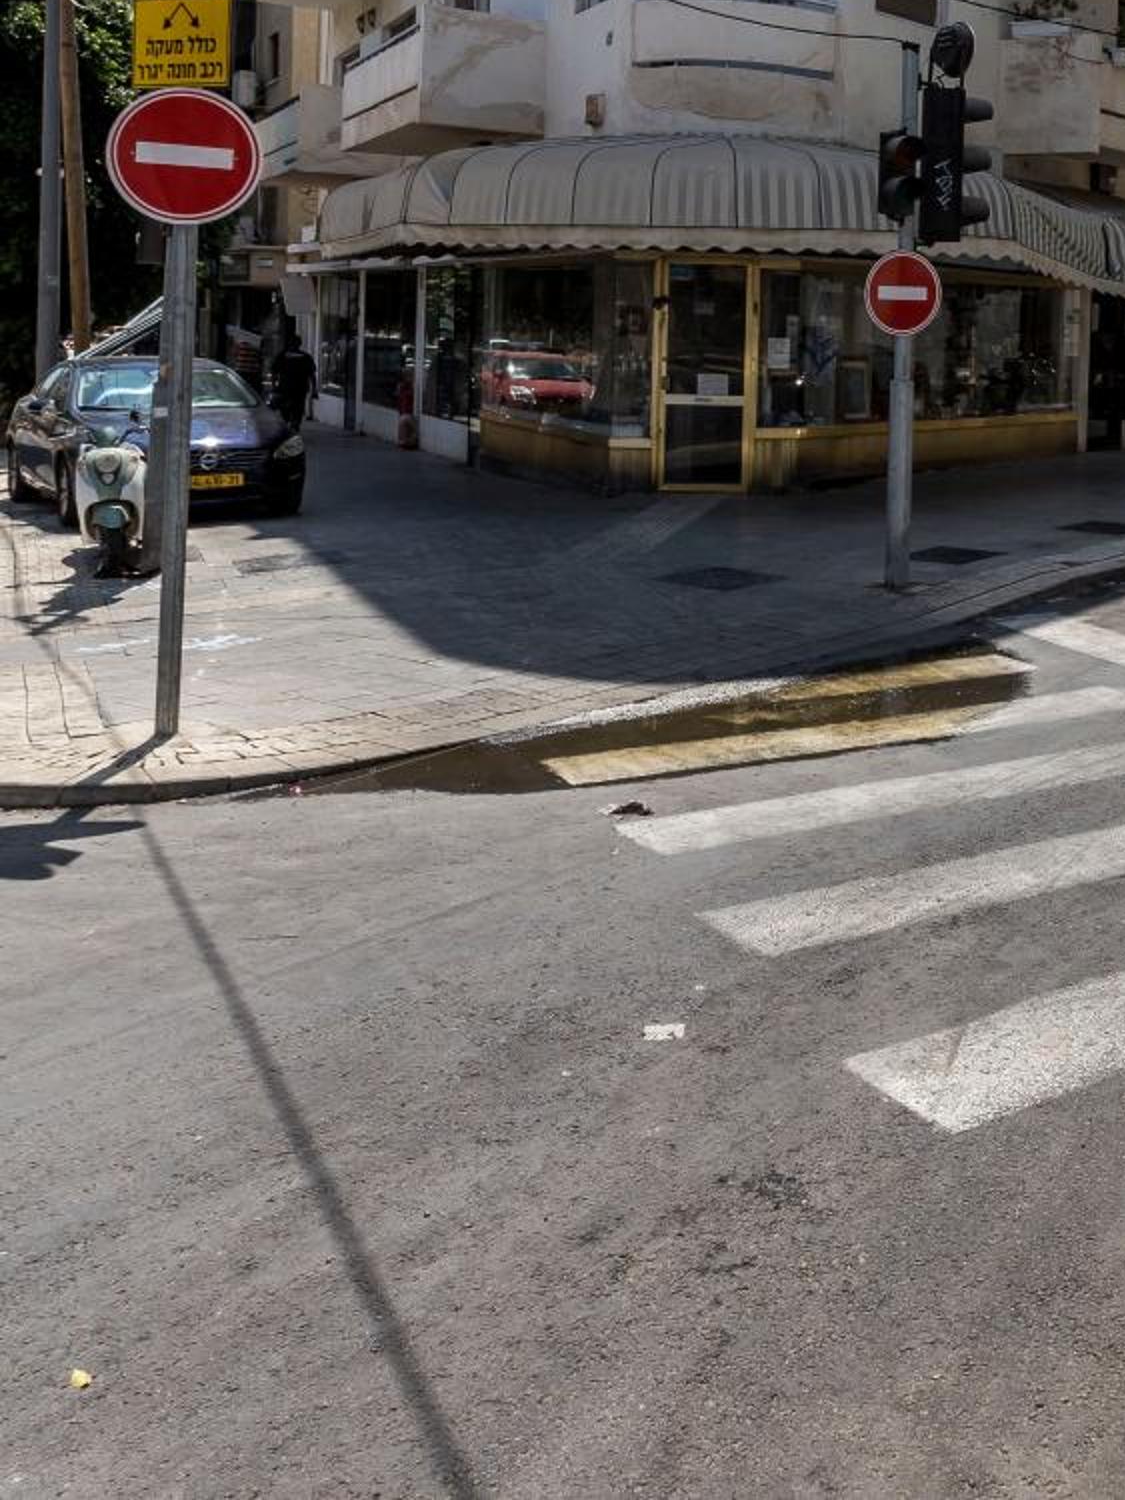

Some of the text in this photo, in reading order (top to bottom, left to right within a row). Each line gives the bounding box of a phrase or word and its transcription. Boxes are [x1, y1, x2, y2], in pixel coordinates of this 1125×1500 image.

[188, 36, 216, 53] כולל
[168, 64, 197, 78] חונה
[200, 62, 223, 78] רכב
